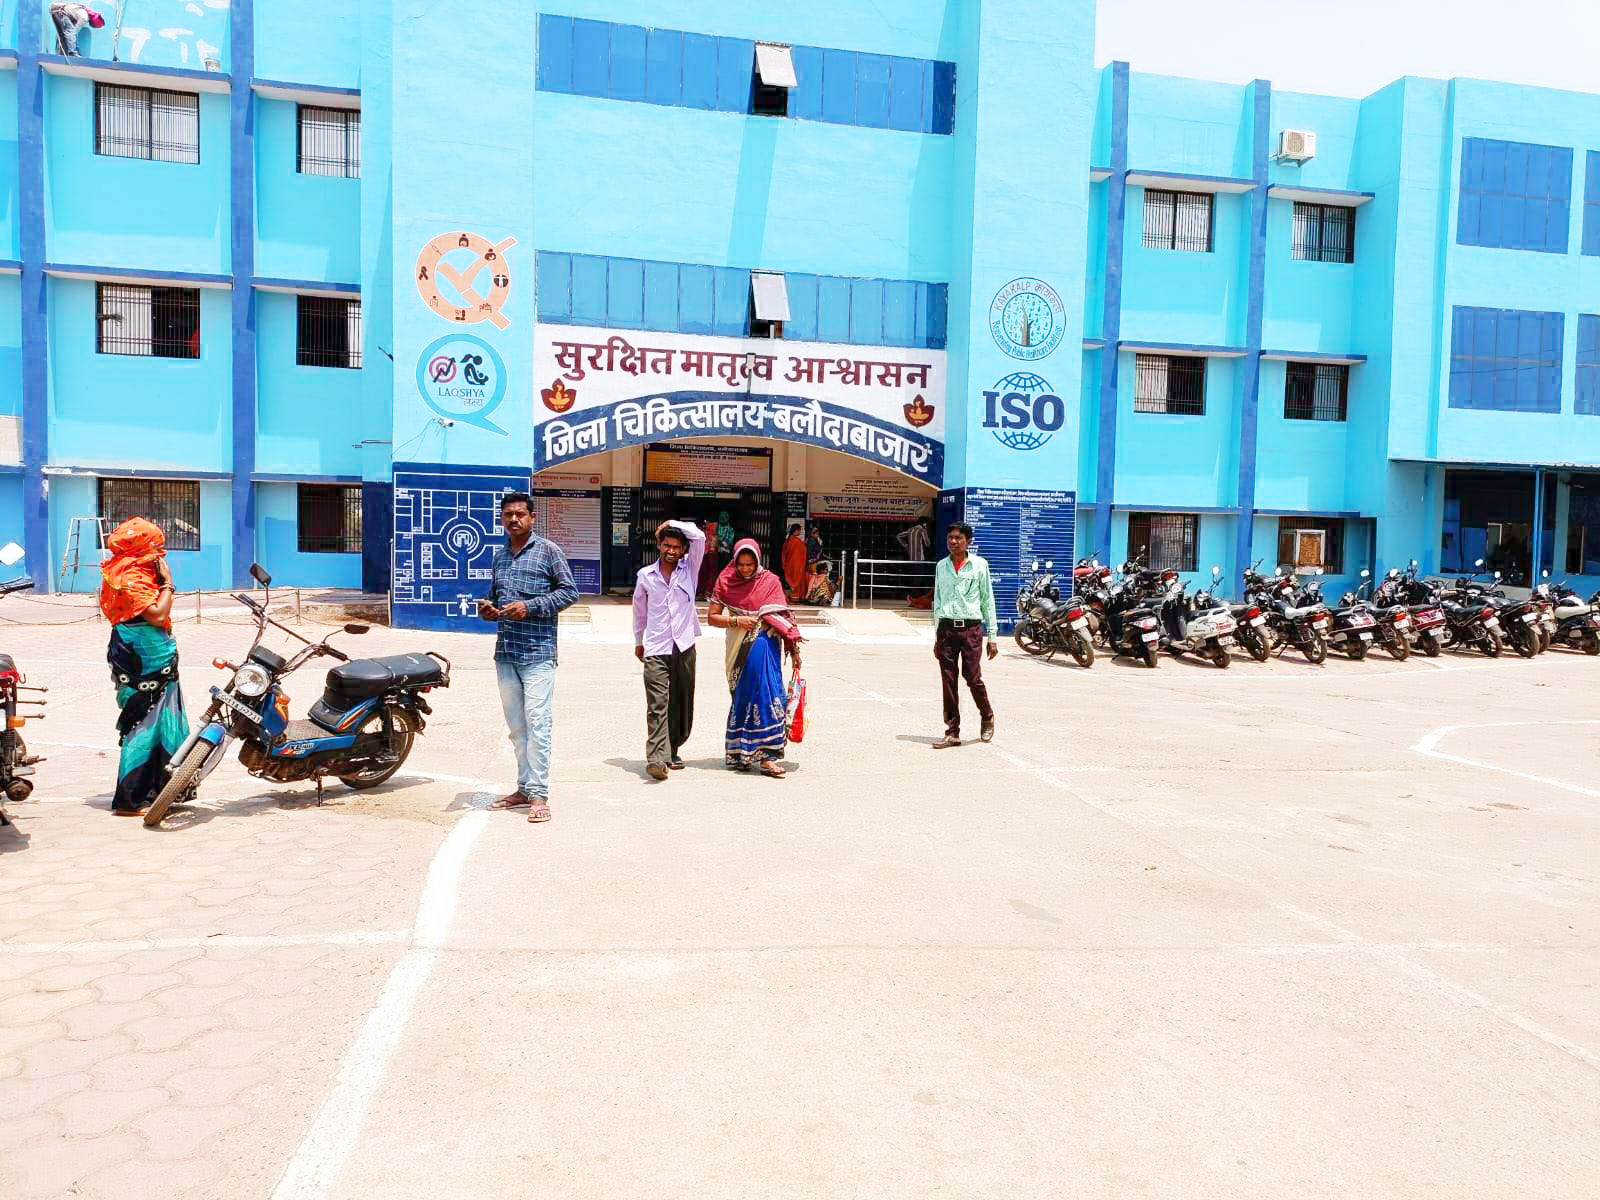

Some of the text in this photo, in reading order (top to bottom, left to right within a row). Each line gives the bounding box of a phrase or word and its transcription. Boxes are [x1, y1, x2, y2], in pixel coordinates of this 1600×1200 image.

[994, 281, 1031, 311] KAYAKALP
[552, 335, 676, 381] सुरक्षित
[680, 349, 778, 386] मातृत्व
[438, 386, 485, 399] LAQSHYA
[982, 390, 1065, 432] ISO
[542, 420, 608, 462] जिला
